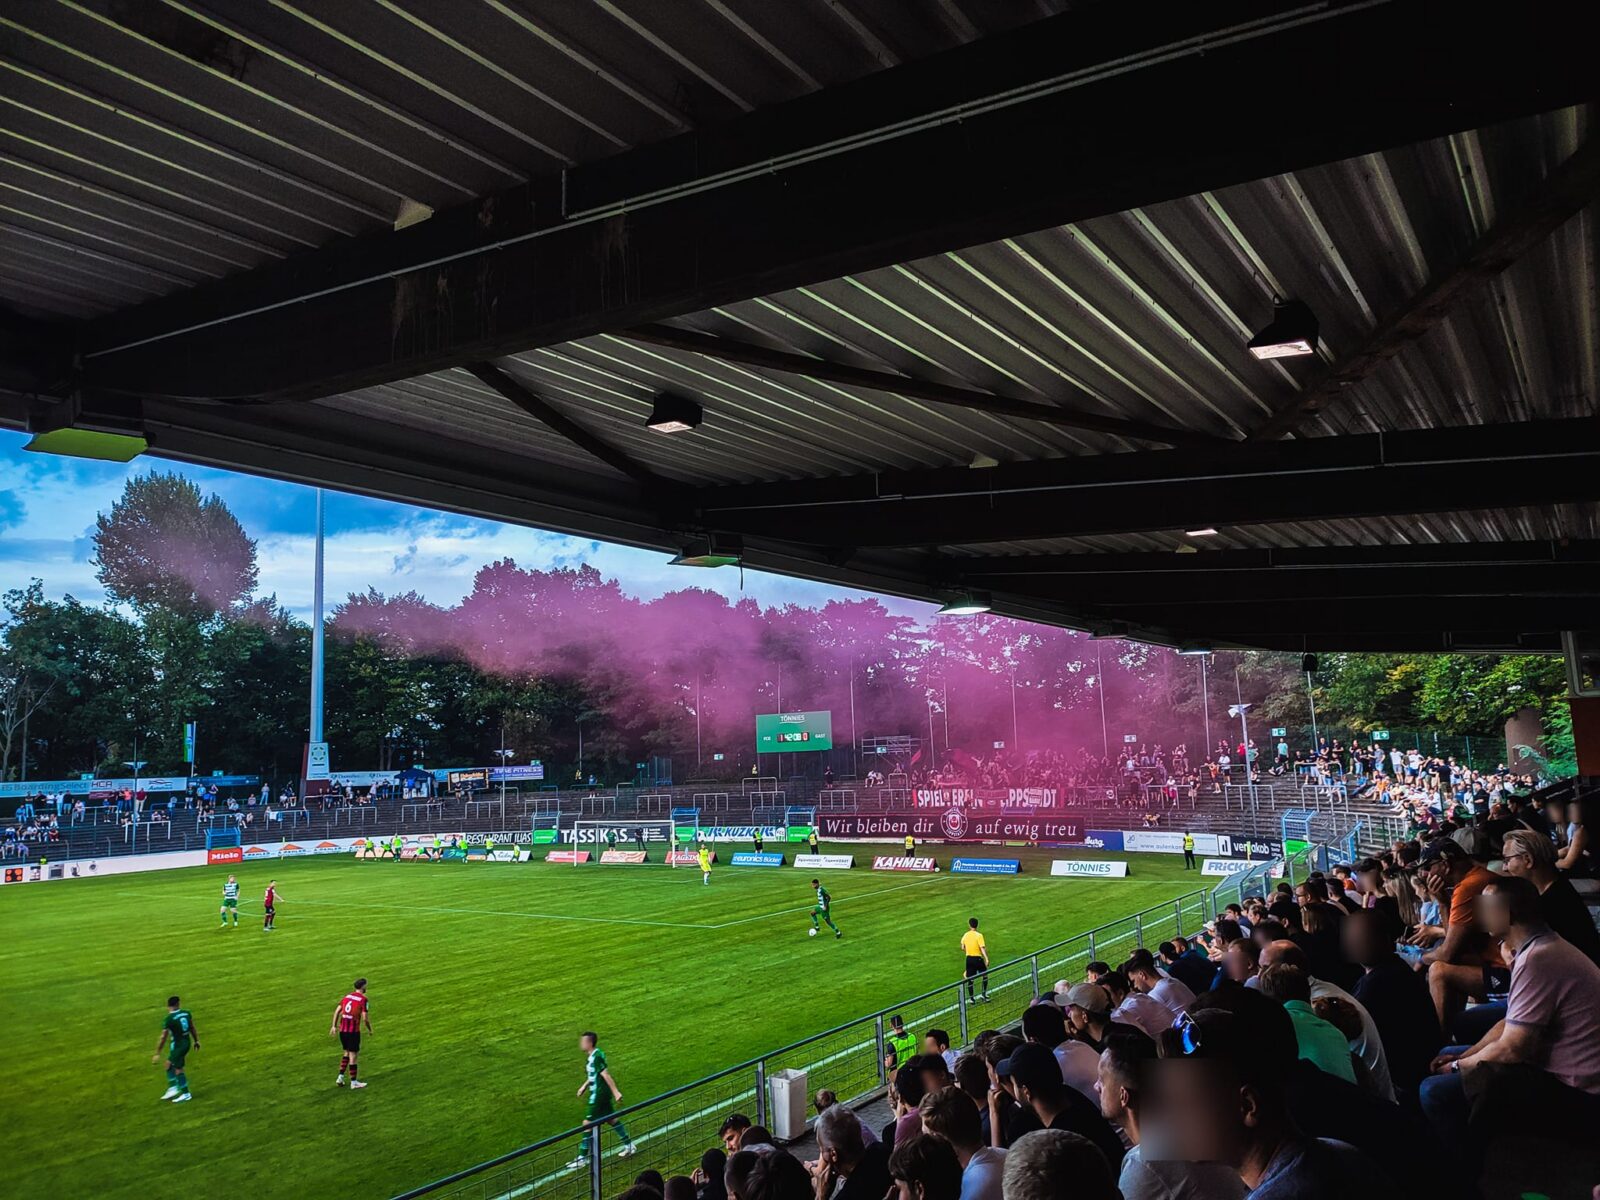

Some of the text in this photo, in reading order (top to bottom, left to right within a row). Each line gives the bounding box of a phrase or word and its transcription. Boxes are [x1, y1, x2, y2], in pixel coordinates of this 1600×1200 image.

[780, 714, 805, 722] TÖNNIES
[826, 818, 1077, 840] Wir bleiben dir auf ewig treu
[211, 852, 239, 861] Miele
[875, 856, 934, 869] KAHMEN
[1066, 862, 1111, 873] TÖNNIES
[344, 1000, 352, 1013] 6
